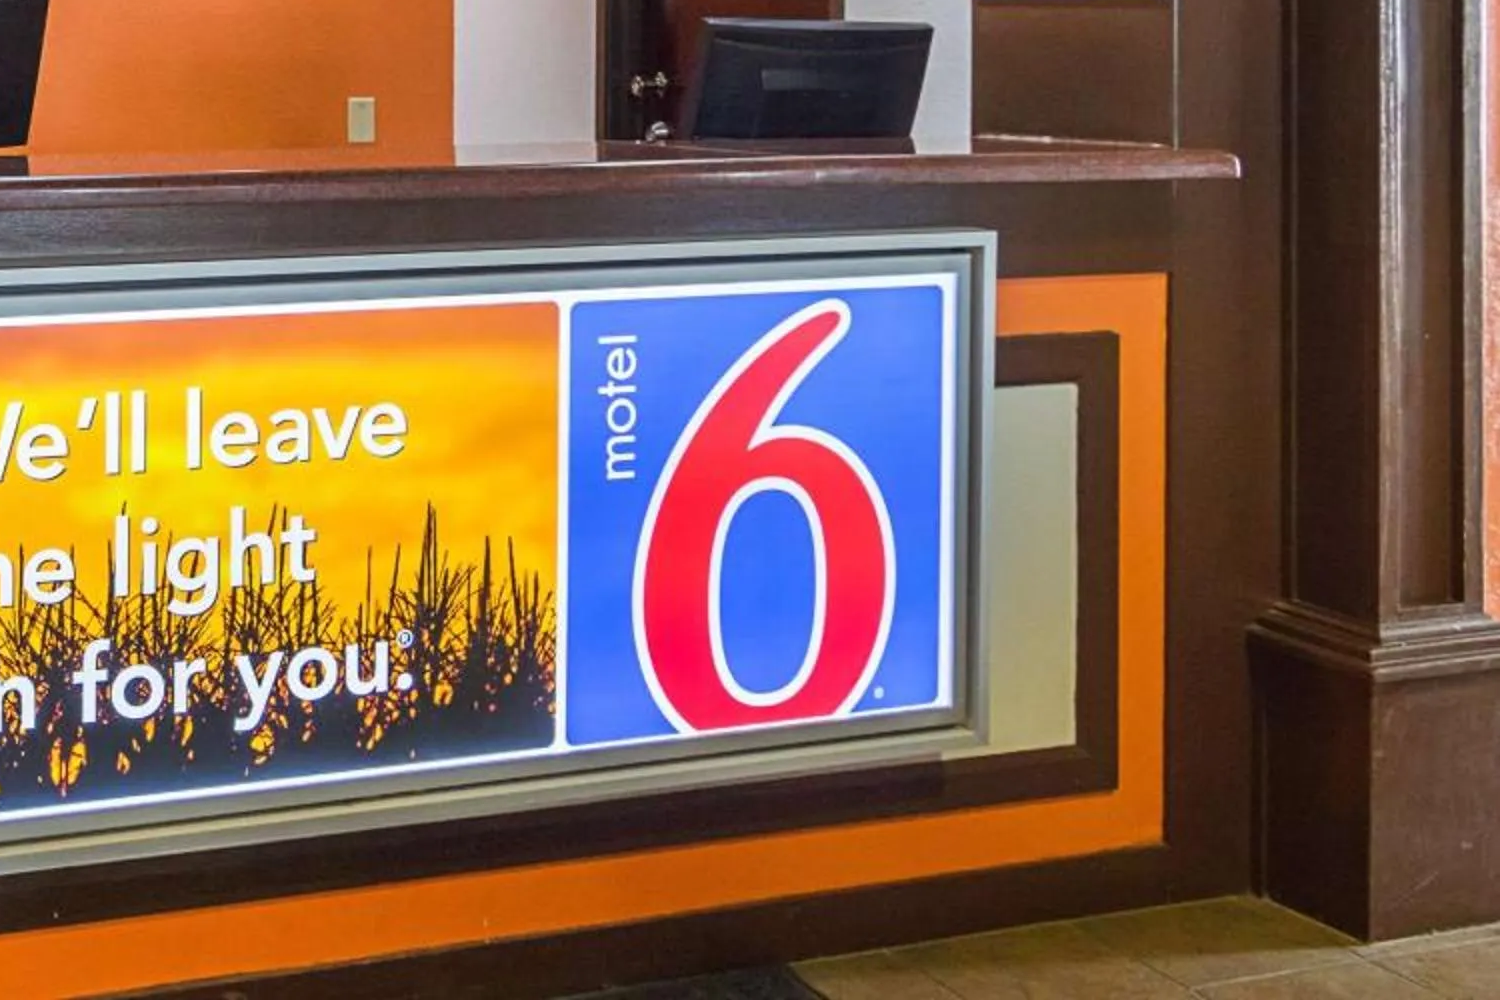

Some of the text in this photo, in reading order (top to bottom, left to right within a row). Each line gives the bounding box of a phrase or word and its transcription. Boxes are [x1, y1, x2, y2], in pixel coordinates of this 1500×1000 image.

[186, 386, 407, 470] leave
[598, 334, 638, 481] motel
[114, 505, 316, 618] light
[631, 298, 897, 736] 6
[72, 638, 207, 724] for
